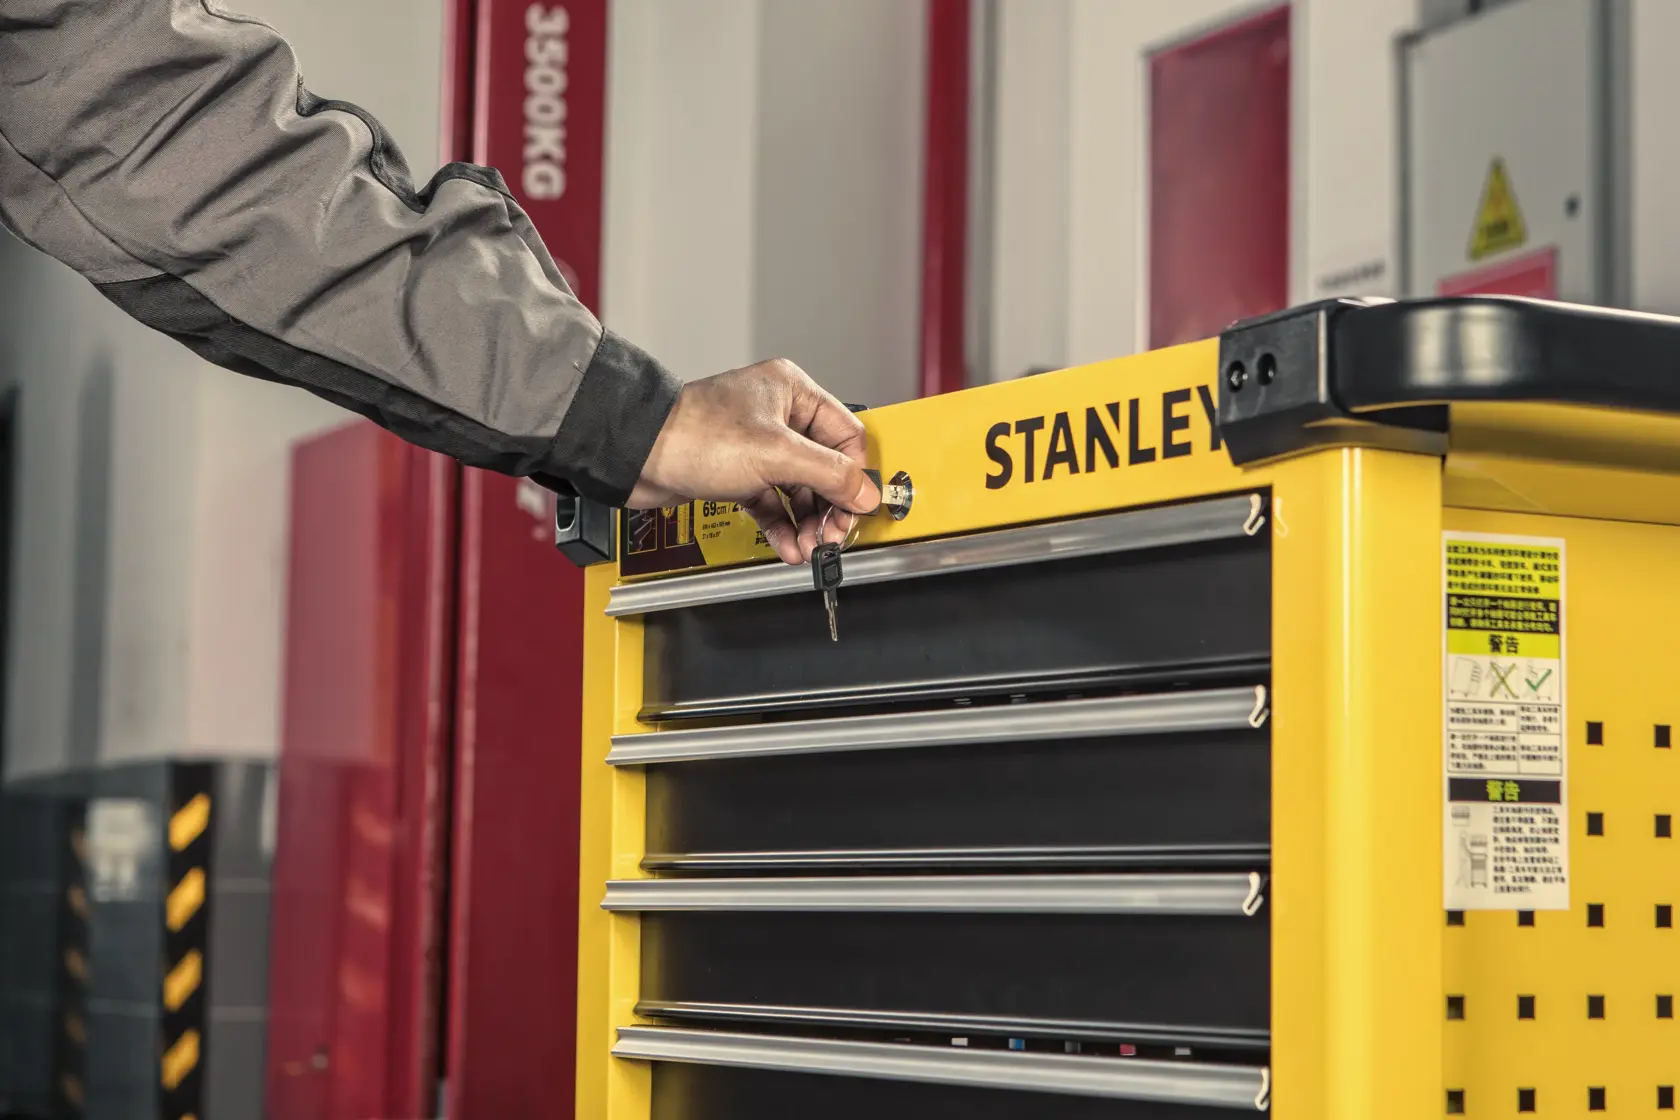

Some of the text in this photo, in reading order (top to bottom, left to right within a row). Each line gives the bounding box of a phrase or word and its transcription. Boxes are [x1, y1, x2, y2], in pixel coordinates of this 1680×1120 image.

[523, 2, 570, 200] 3500KG
[985, 384, 1222, 490] STANLEY
[703, 501, 727, 518] 69cm
[1488, 634, 1520, 654] 警告
[1486, 779, 1520, 801] 警告
